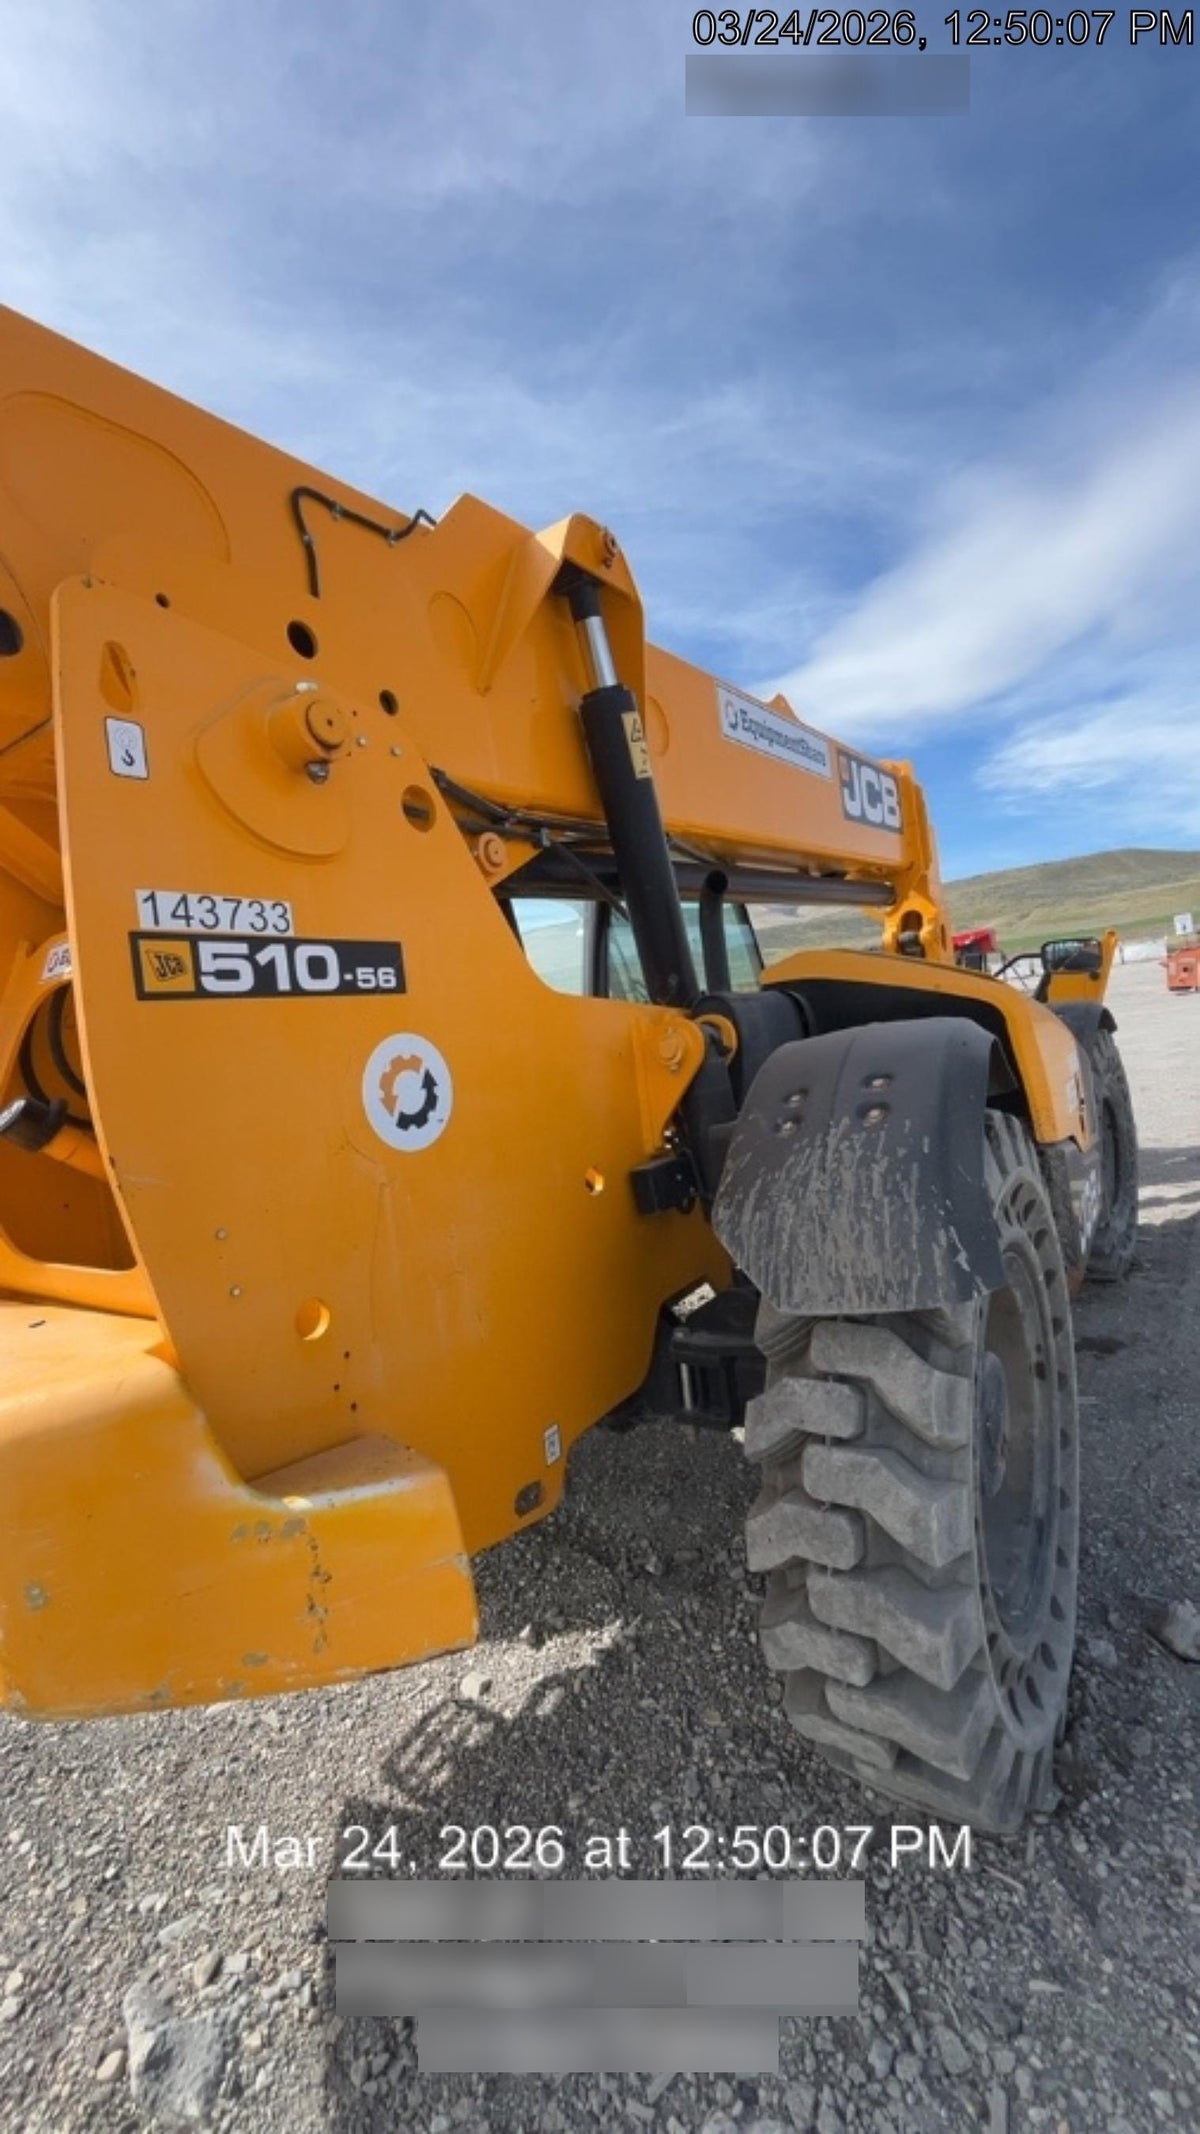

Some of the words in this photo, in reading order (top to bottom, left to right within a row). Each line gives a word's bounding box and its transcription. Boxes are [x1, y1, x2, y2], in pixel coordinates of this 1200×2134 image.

[841, 757, 901, 829] JCB
[142, 890, 291, 933] 143733
[152, 953, 188, 981] JCB
[198, 941, 397, 993] 510-56
